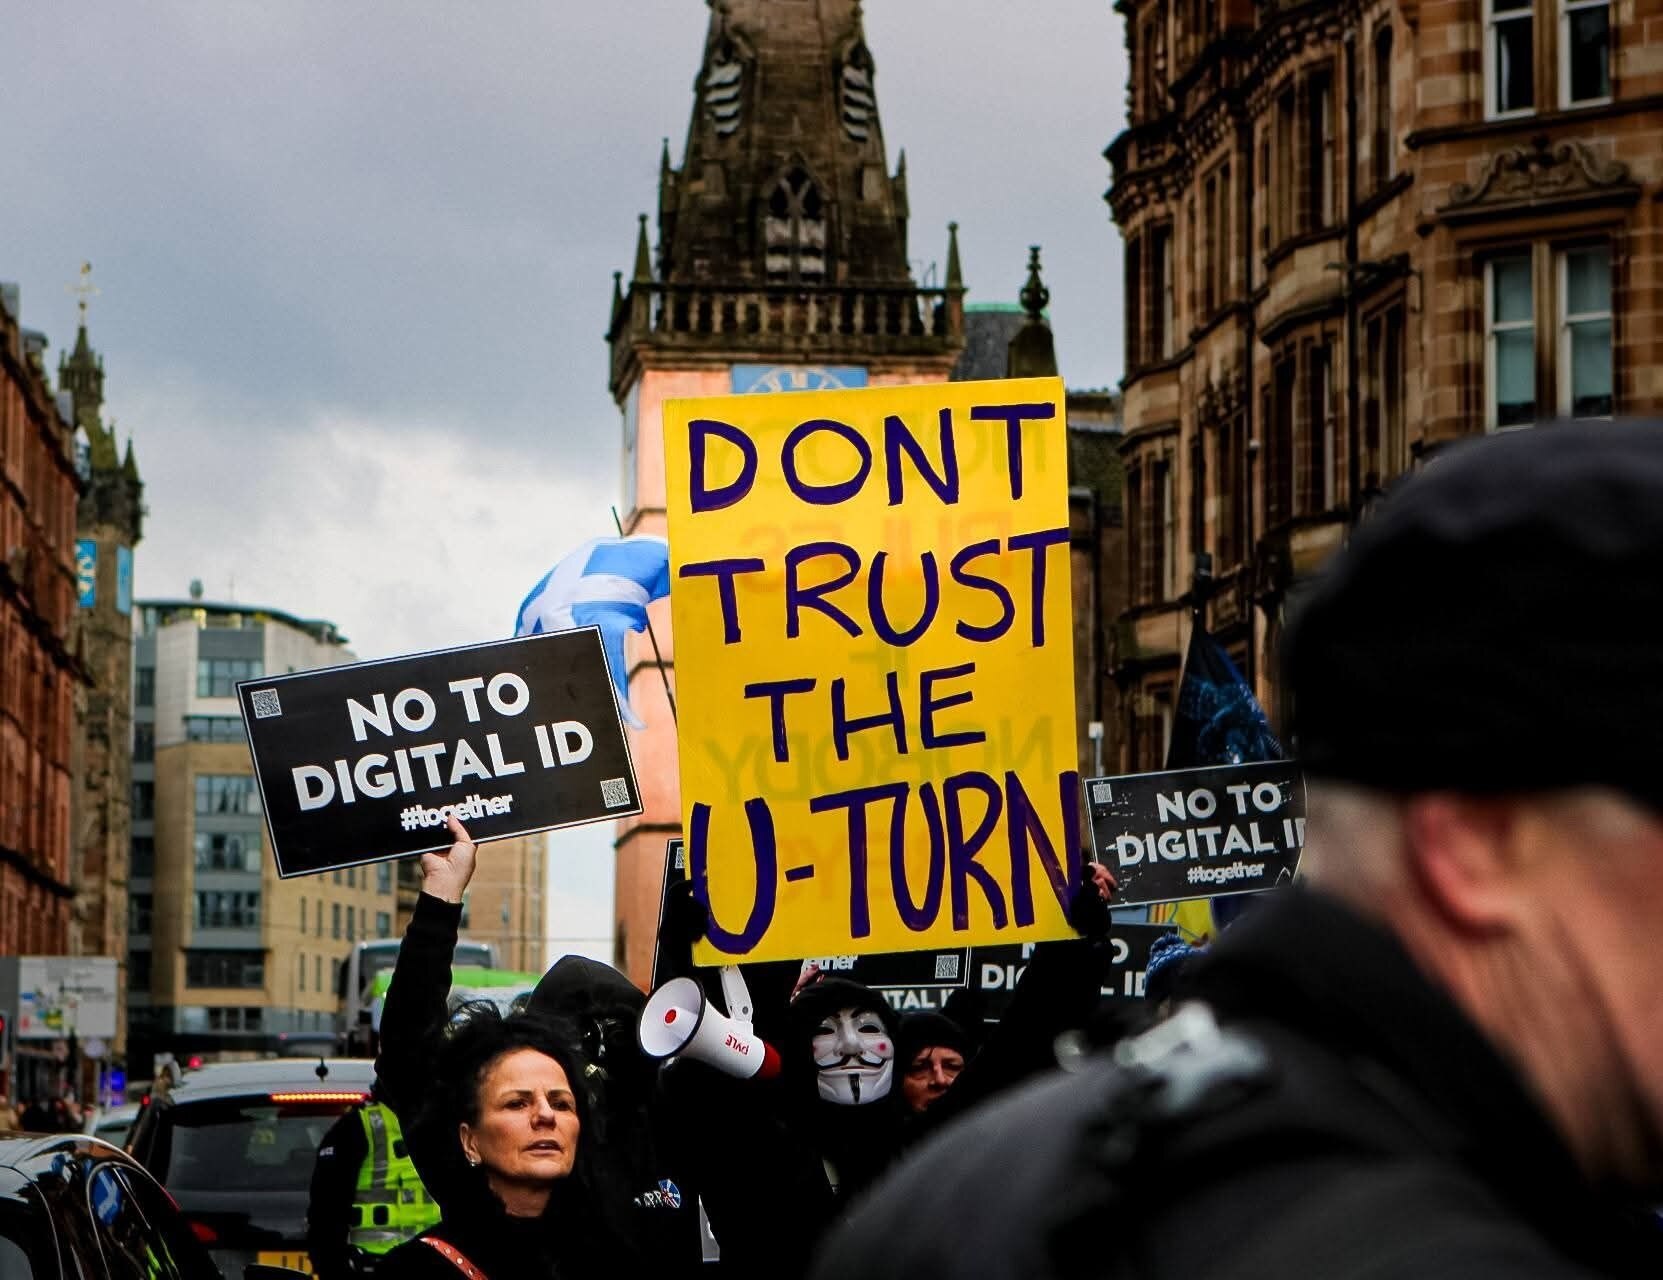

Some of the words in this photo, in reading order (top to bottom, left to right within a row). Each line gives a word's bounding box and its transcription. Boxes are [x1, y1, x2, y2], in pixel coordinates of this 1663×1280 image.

[688, 402, 1056, 514] DONT
[679, 526, 1071, 648] TRUST
[347, 687, 437, 742] NO
[448, 672, 530, 723] TO
[743, 662, 987, 763] THE
[291, 733, 526, 812] DIGITAL
[534, 720, 594, 769] ID
[1156, 788, 1217, 823] NO
[1226, 782, 1282, 815] TO
[400, 793, 514, 832] #together
[1115, 823, 1275, 867] DIGITAL
[689, 770, 1082, 955] U-TURN
[1187, 861, 1265, 884] #together
